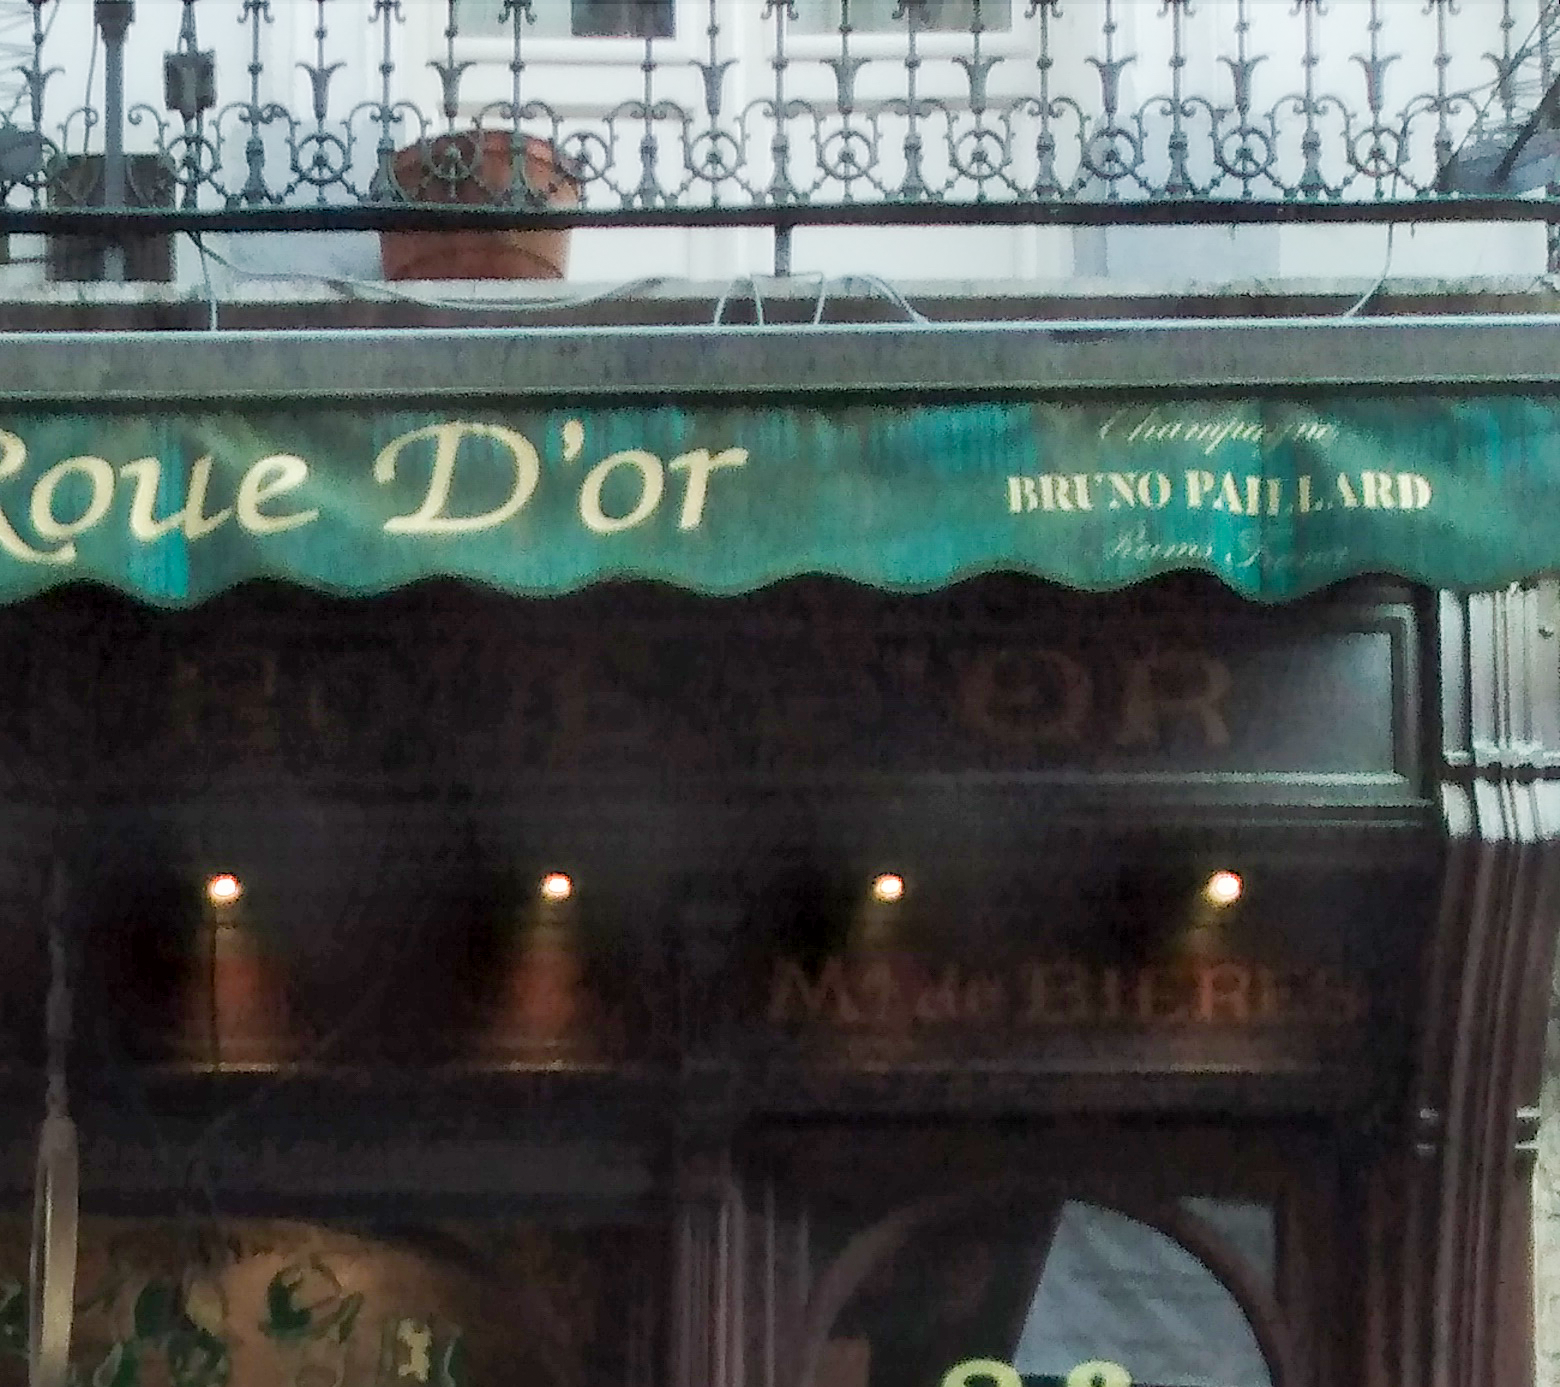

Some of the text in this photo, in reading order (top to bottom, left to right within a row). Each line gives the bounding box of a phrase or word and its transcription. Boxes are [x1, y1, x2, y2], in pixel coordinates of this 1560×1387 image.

[372, 419, 749, 536] D'or
[1005, 469, 1432, 516] BRUNO PAILLARD
